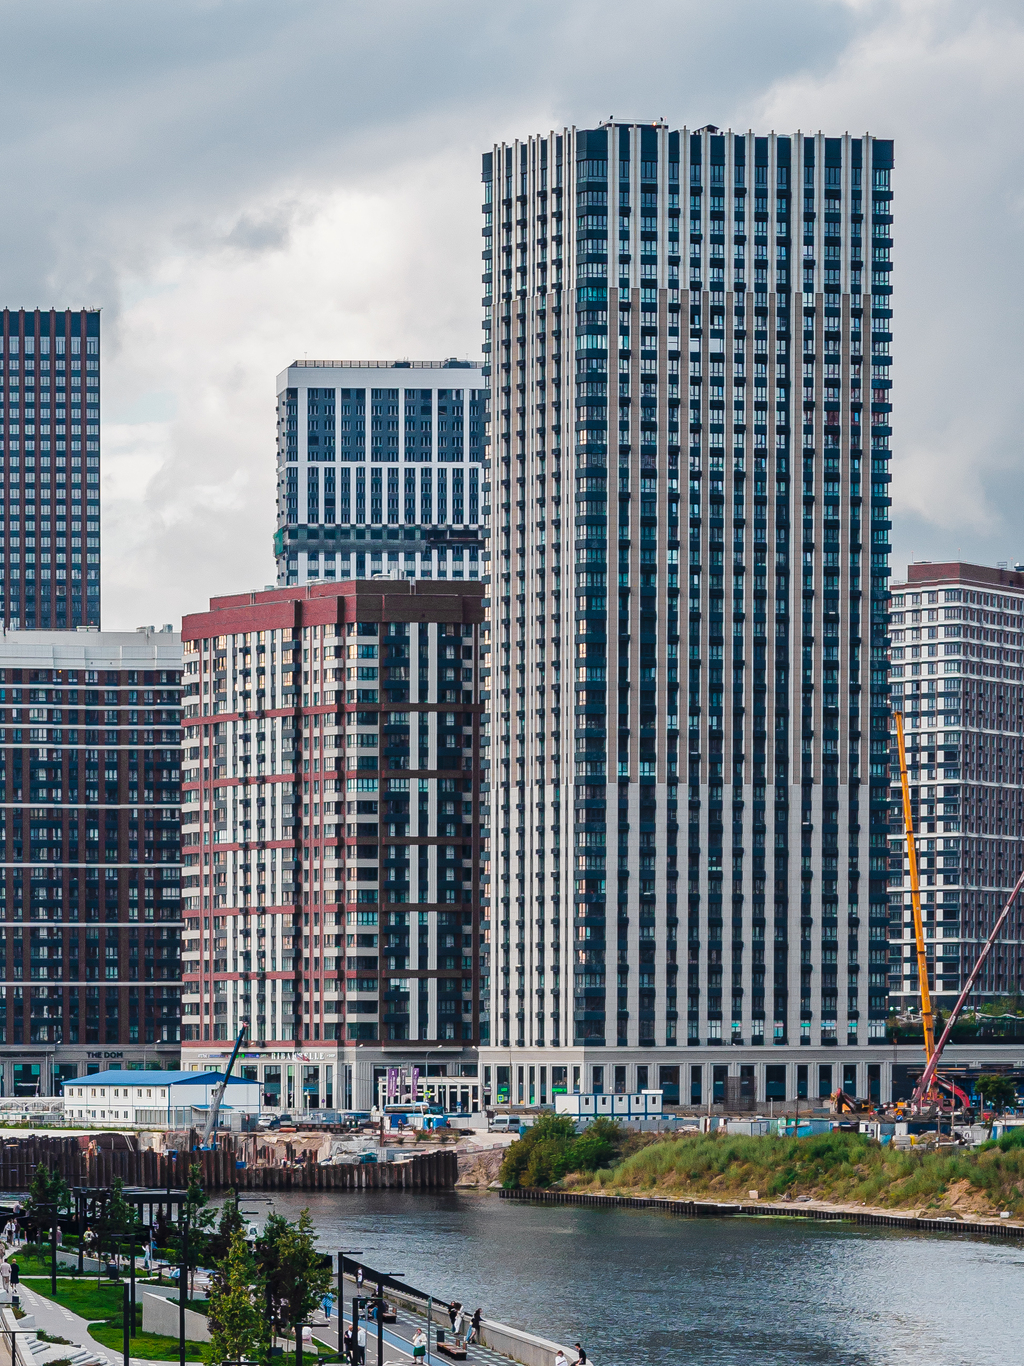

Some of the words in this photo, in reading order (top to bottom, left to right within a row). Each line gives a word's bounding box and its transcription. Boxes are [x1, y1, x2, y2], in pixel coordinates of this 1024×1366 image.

[86, 1051, 102, 1059] THE
[104, 1051, 123, 1059] DOM
[271, 1052, 325, 1060] RIBAELLE
